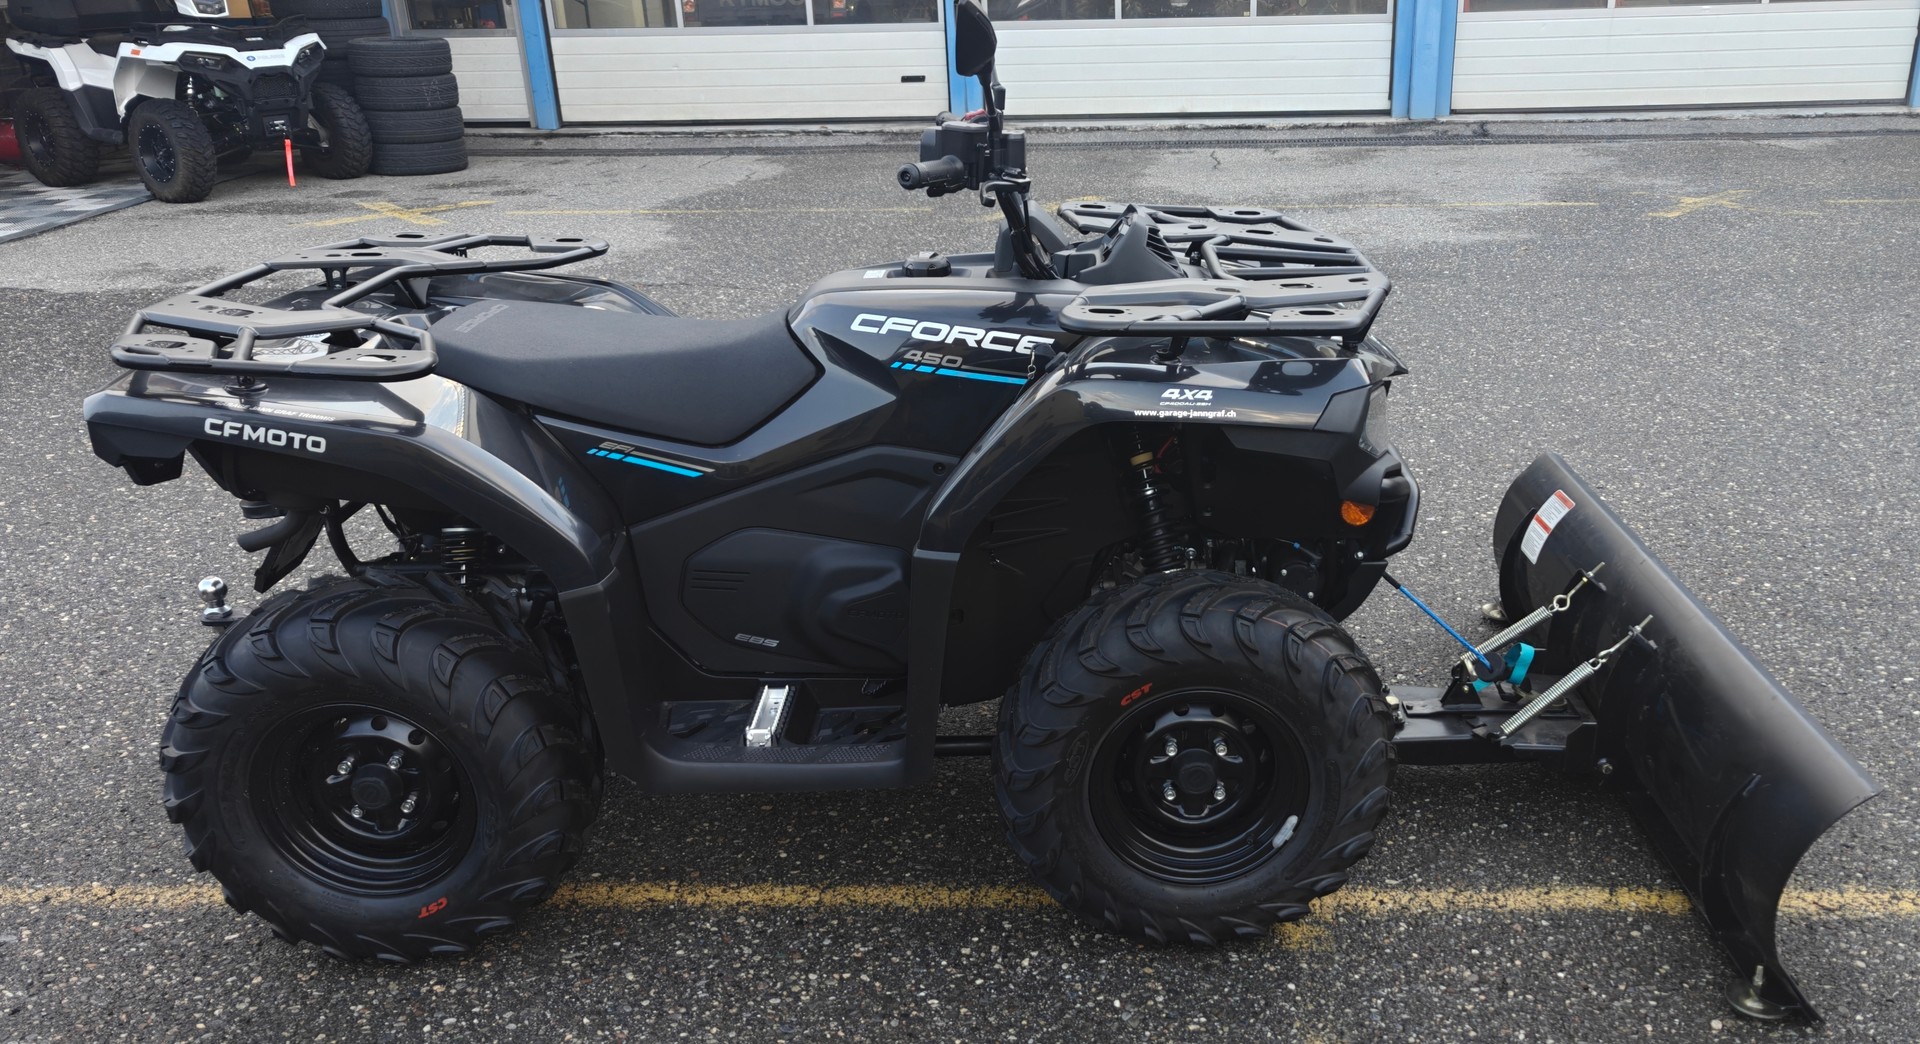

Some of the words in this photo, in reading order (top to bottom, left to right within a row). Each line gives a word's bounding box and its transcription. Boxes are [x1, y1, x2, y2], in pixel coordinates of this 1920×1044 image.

[850, 313, 1055, 355] CFORCE
[903, 350, 963, 368] 450
[1134, 408, 1237, 418] www.garage-janngraf.ch
[204, 417, 326, 453] CFMOTO
[599, 441, 635, 453] EFI
[735, 633, 780, 647] EBS
[1120, 681, 1153, 706] CST
[418, 896, 448, 919] CST
